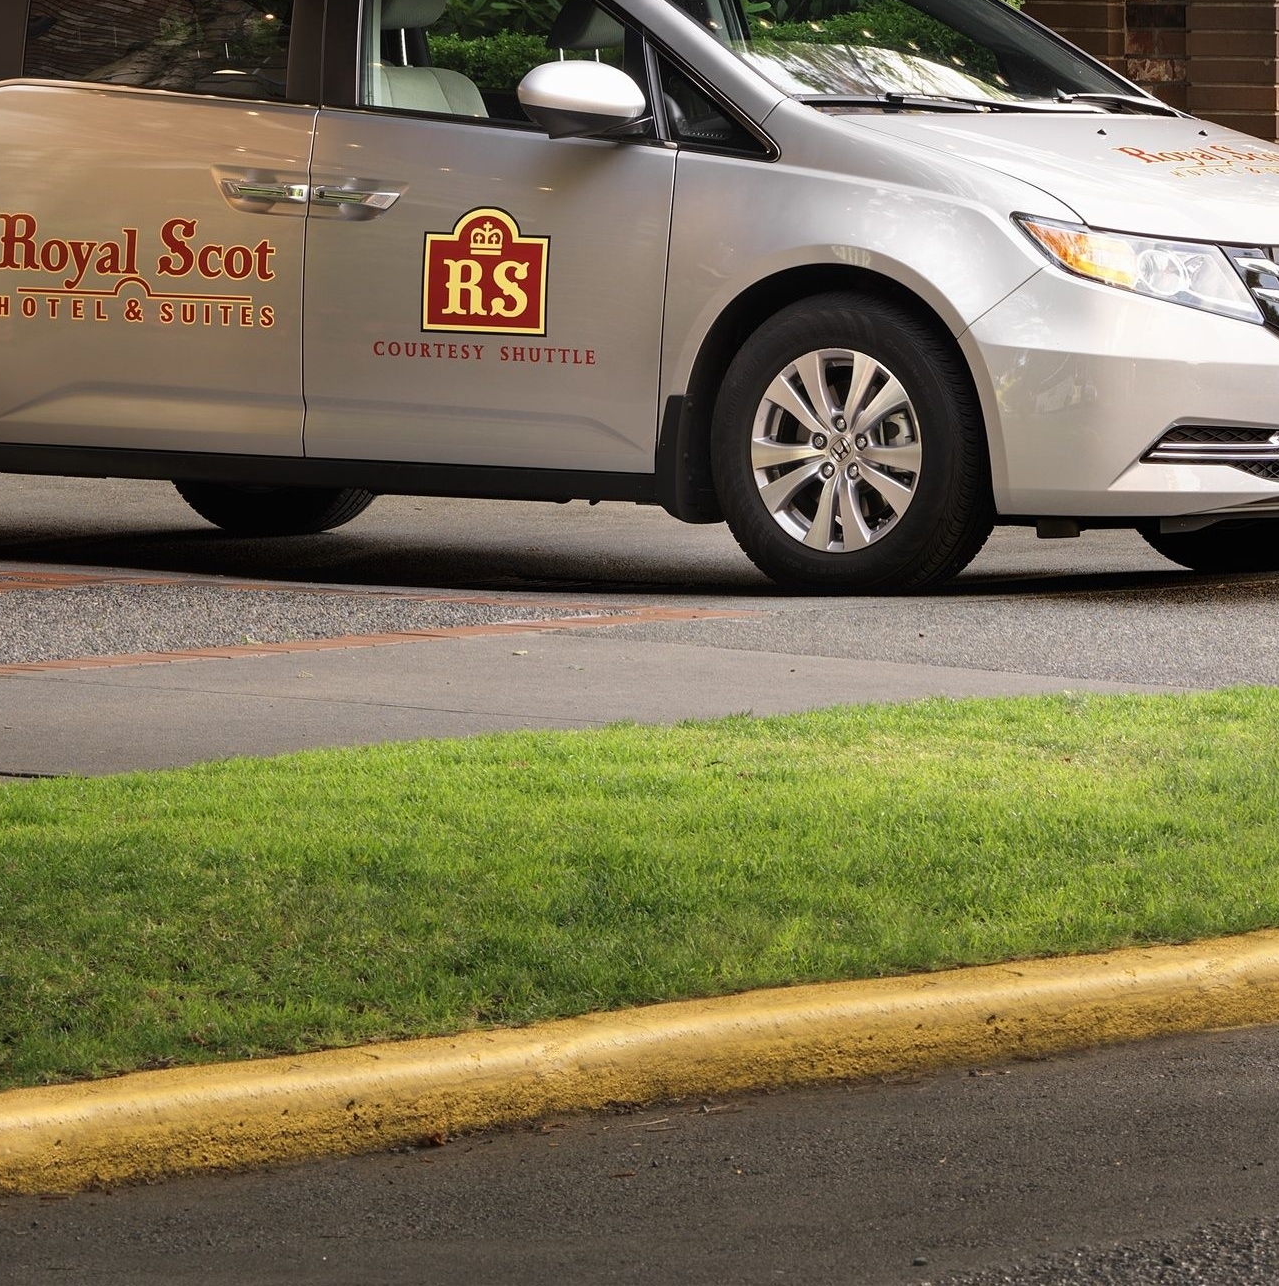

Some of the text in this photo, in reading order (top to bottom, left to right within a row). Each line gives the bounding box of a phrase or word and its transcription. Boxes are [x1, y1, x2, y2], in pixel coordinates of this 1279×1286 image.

[156, 218, 275, 280] Scot
[442, 258, 530, 318] RS
[124, 299, 143, 323] &
[160, 302, 274, 328] SUITES
[373, 341, 596, 365] COURTESY SHUTTLE
